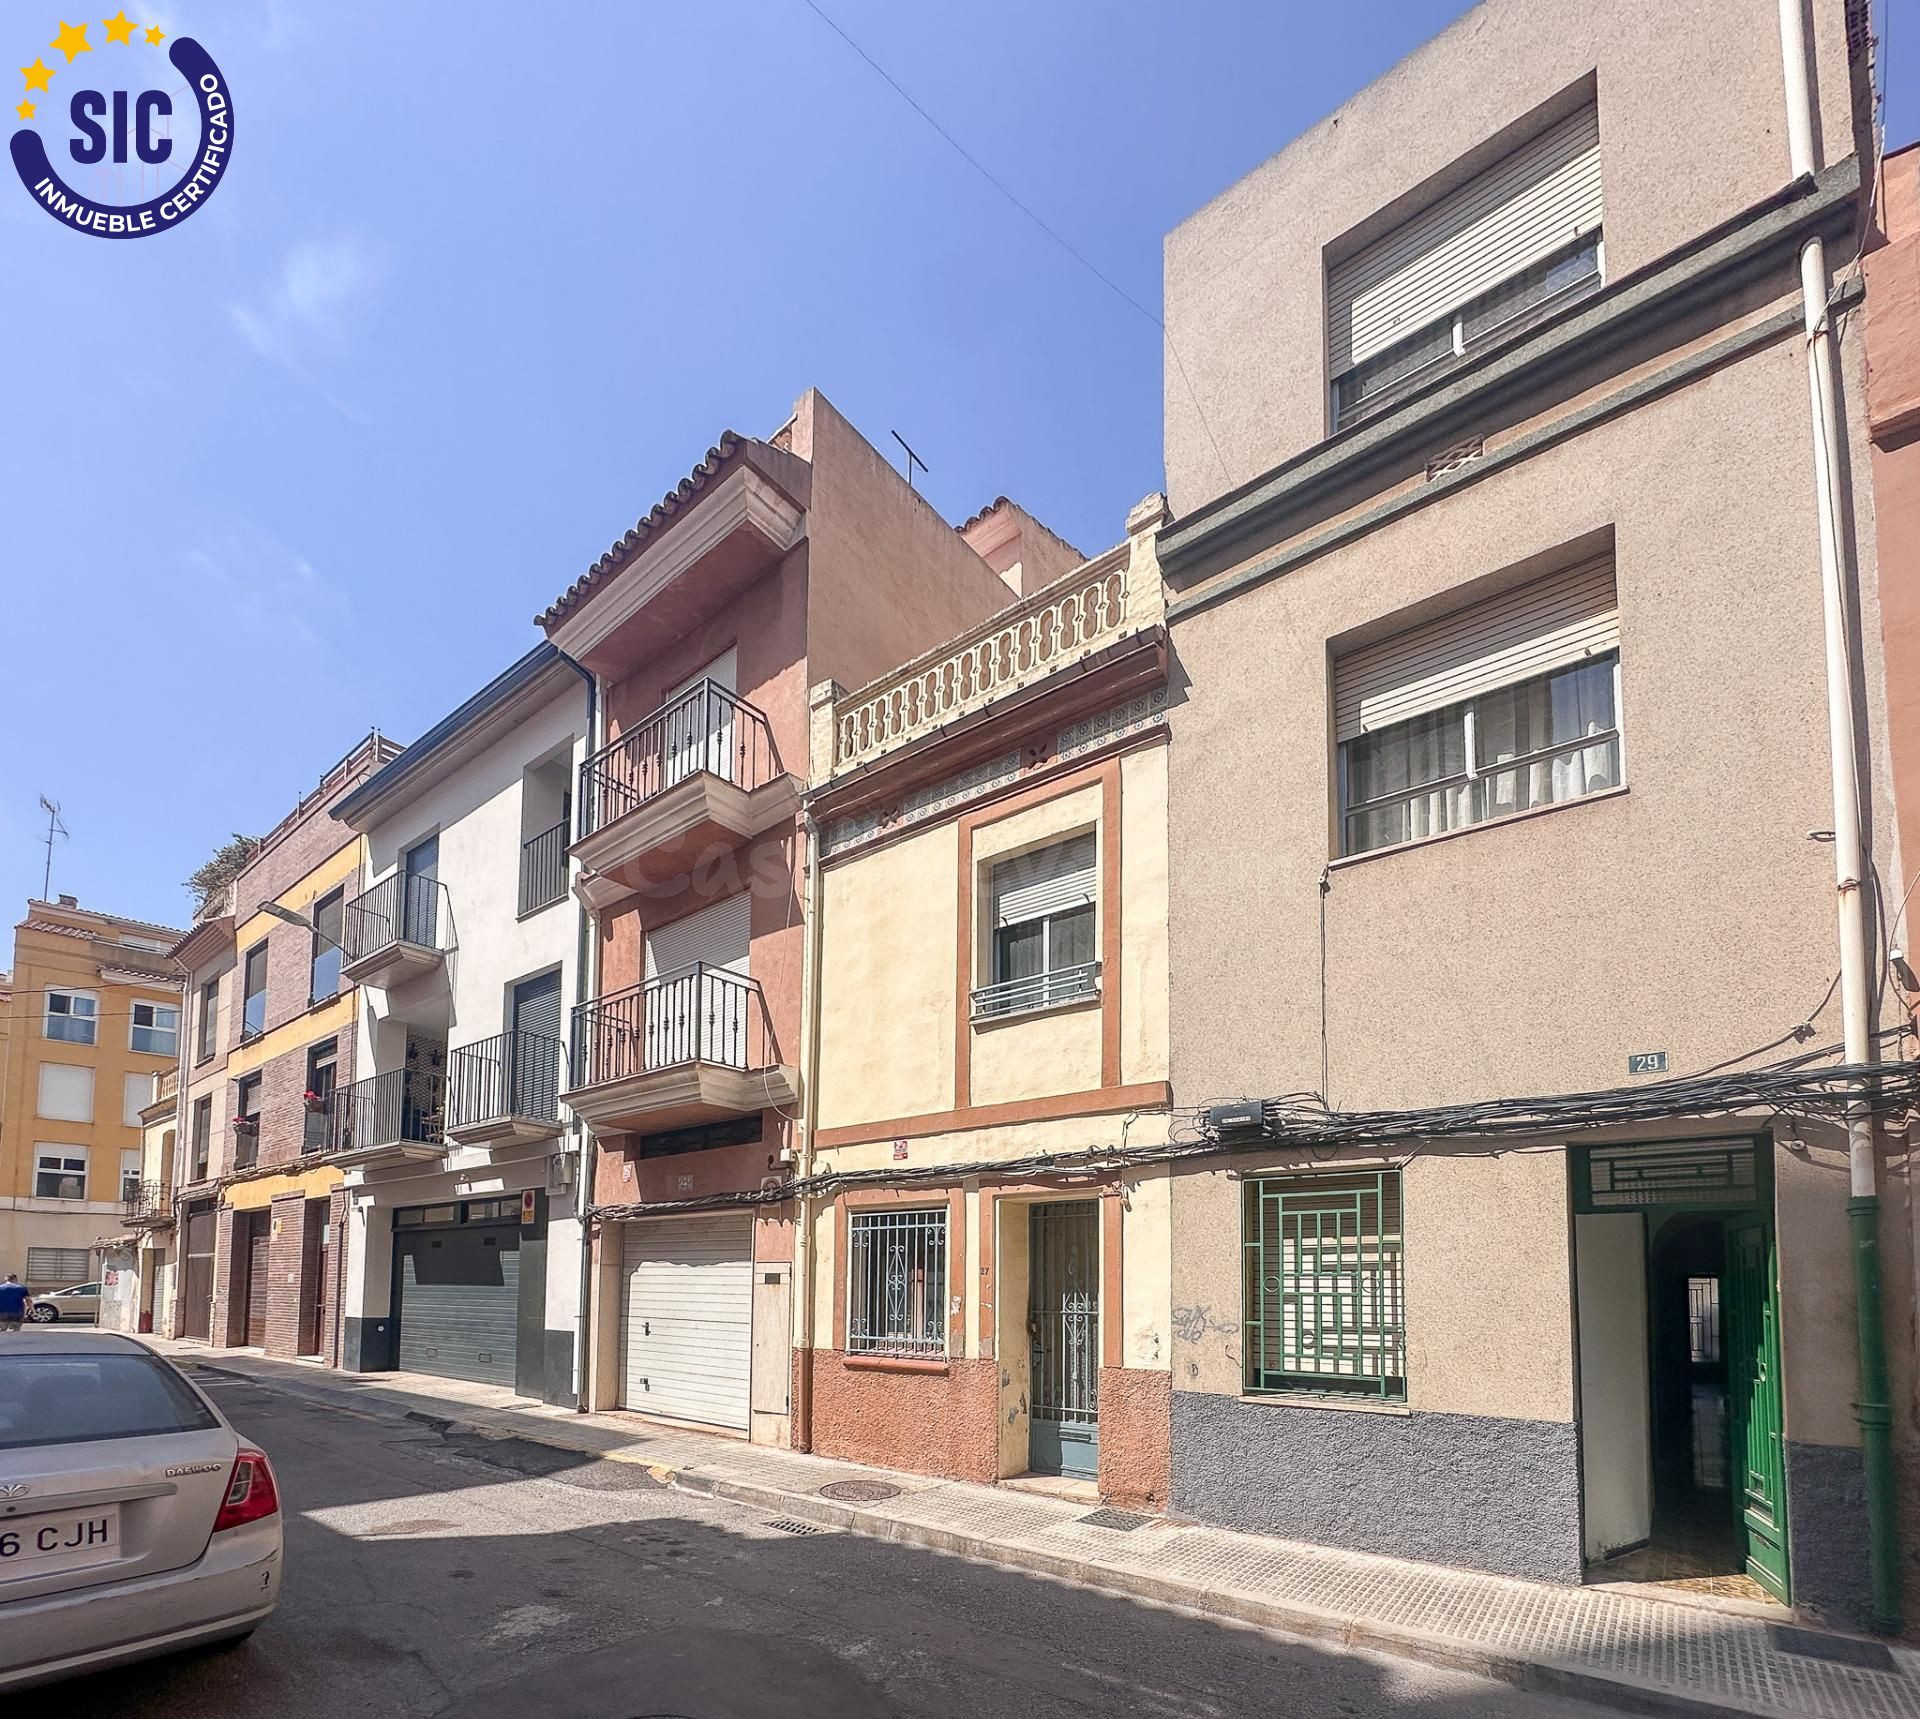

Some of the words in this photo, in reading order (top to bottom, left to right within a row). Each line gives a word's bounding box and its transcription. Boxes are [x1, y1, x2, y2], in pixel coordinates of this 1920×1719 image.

[1636, 1054, 1659, 1072] 29
[979, 1266, 990, 1276] 27
[165, 1463, 223, 1478] DAEWOO
[0, 1532, 20, 1557] 6
[36, 1519, 108, 1551] CJH
